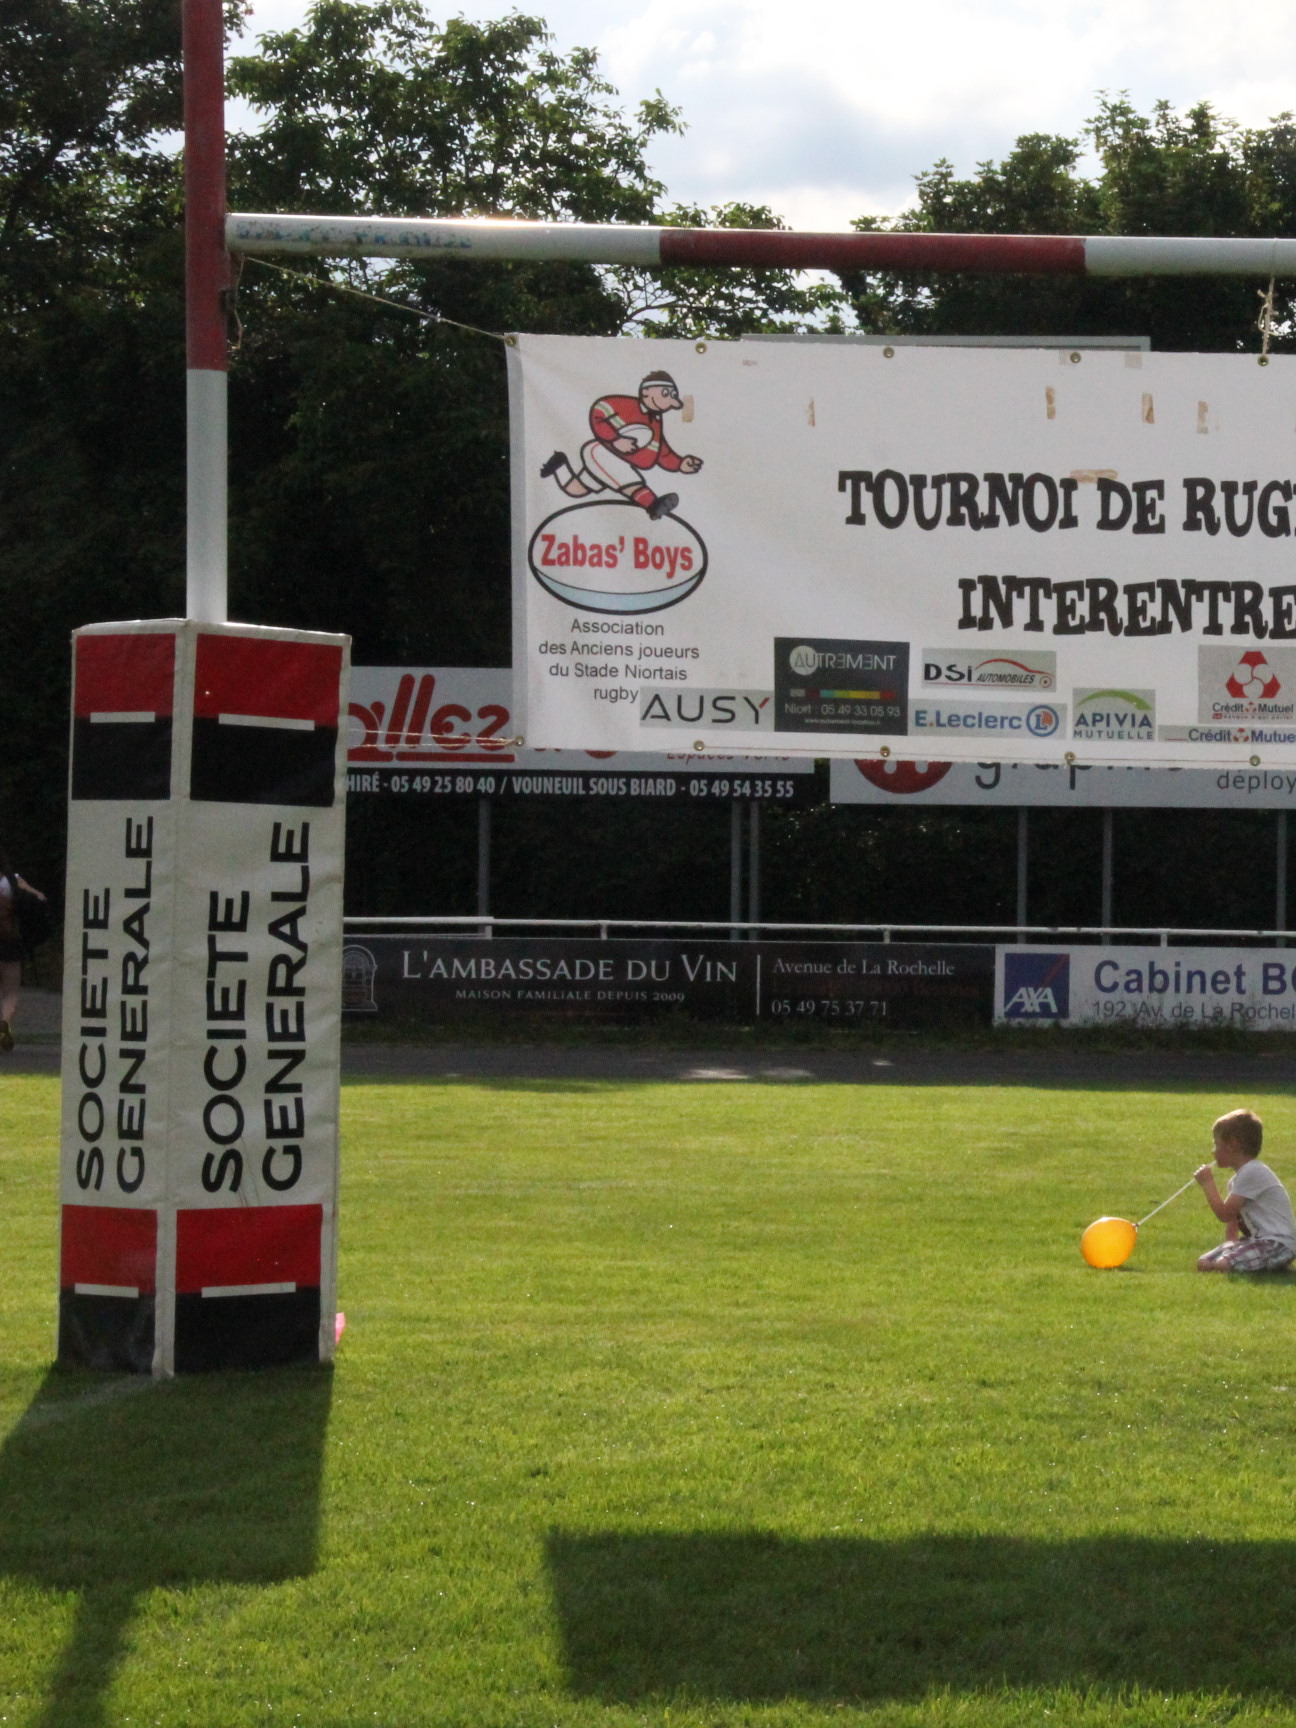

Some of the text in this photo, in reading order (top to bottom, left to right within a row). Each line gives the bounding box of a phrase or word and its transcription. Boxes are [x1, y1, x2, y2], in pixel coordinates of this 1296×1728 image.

[838, 469, 1079, 532] TOURNOI
[1096, 477, 1166, 534] DE
[633, 537, 693, 578] Boys
[571, 619, 664, 636] Association
[538, 641, 700, 661] des Anciens joueurs
[549, 663, 687, 680] du Stade Niortais
[976, 673, 1036, 685] AUTOMOBILES
[594, 686, 638, 703] rugby
[641, 693, 770, 724] AUSY
[785, 703, 900, 717] Niort 05 49 33 05 93
[1212, 702, 1294, 713] Crédit Mutuel
[915, 709, 1022, 729] E.Leclerc
[1075, 712, 1153, 729] APIVIA
[1074, 730, 1153, 740] MUTUELLE
[1188, 728, 1231, 742] Crédit
[391, 776, 409, 792] 05
[413, 776, 431, 793] 49
[434, 776, 452, 793] 25
[456, 776, 474, 793] 80
[477, 777, 495, 793] 40
[512, 777, 586, 795] VOUNEUIL
[589, 777, 626, 795] SOUS
[630, 777, 676, 796] BIARD
[690, 780, 708, 796] 05
[711, 780, 729, 797] 49
[733, 780, 750, 797] 54
[755, 780, 772, 797] 35
[776, 781, 794, 798] 55
[773, 958, 956, 975] Avenue de La Rochelle
[1094, 960, 1246, 995] Cabinet
[117, 816, 154, 1193] GENERALE
[456, 989, 685, 1002] MAISON FAMILIALE DEPUIS 2009
[1004, 987, 1058, 1014] AXA
[262, 821, 310, 1191] GENERALE
[771, 1000, 887, 1016] 05 49 75 37 71
[1092, 1001, 1126, 1018] 192
[1171, 1002, 1194, 1018] de
[1202, 1002, 1224, 1019] La
[76, 888, 110, 1190] SOCIETE
[202, 890, 250, 1193] SOCIETE
